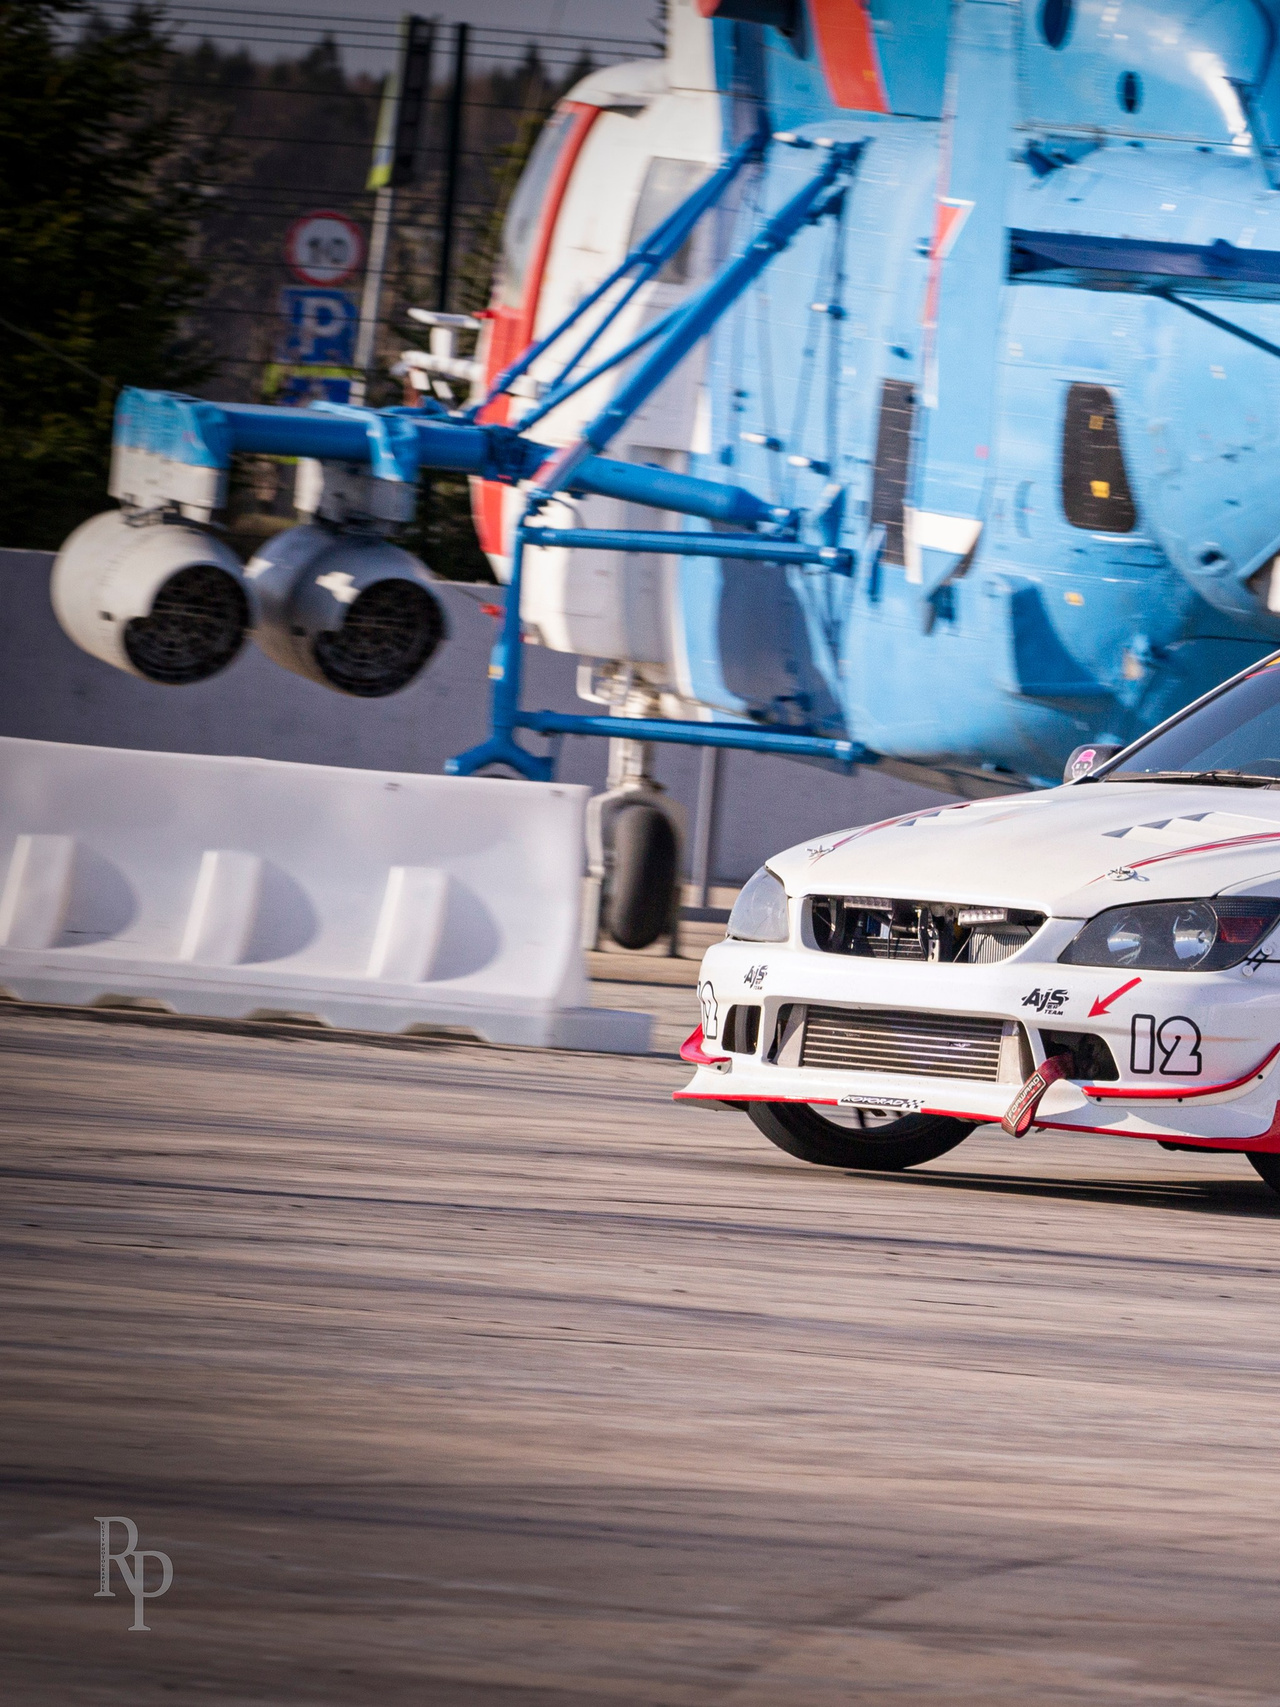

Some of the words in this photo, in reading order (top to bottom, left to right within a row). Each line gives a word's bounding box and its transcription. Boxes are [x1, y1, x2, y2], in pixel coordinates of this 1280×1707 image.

[302, 297, 346, 355] P
[1130, 1013, 1202, 1075] 12
[844, 1096, 906, 1107] KOYORAD
[1008, 1076, 1040, 1118] FORWARD
